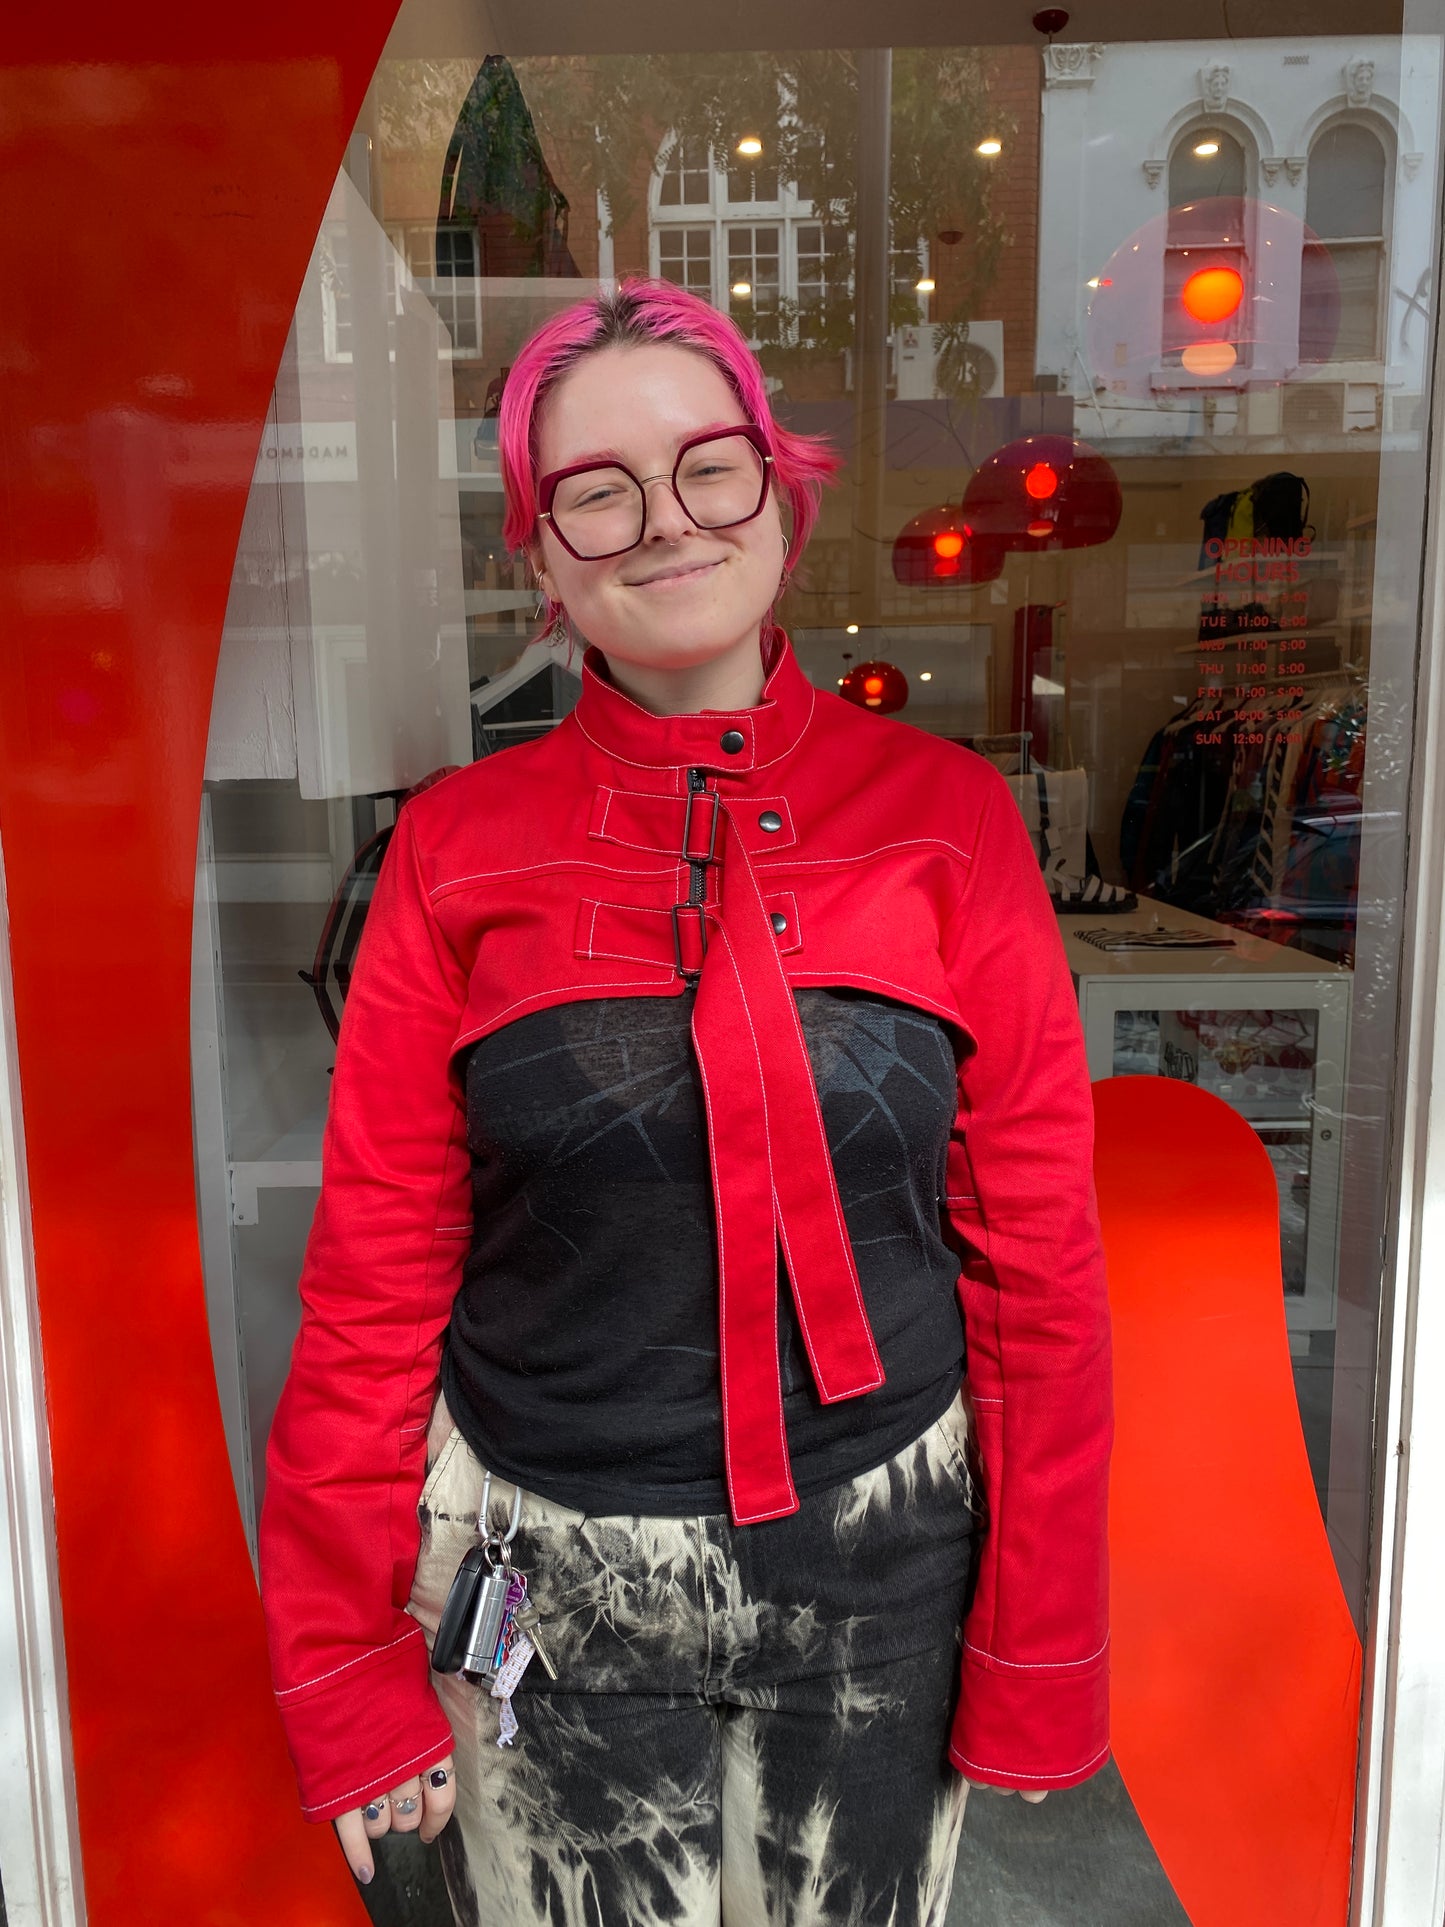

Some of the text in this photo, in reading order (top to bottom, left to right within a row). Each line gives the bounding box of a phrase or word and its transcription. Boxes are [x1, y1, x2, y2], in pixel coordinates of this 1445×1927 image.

[1204, 537, 1312, 559] OPENING
[1215, 562, 1300, 582] HOURS
[1200, 616, 1227, 627] TUE
[1238, 615, 1269, 627] 11:00
[1199, 640, 1226, 651] WED
[1237, 640, 1268, 651] 11:00
[1280, 640, 1306, 652] 5:00
[1199, 663, 1224, 674] THU
[1236, 663, 1267, 674] 11:00
[1278, 663, 1305, 674] 5:00
[1198, 687, 1223, 697] FRI
[1235, 687, 1266, 698] 11:00
[1277, 687, 1304, 698] 5:00
[1197, 711, 1222, 721] SAT
[1196, 734, 1222, 744] SUN
